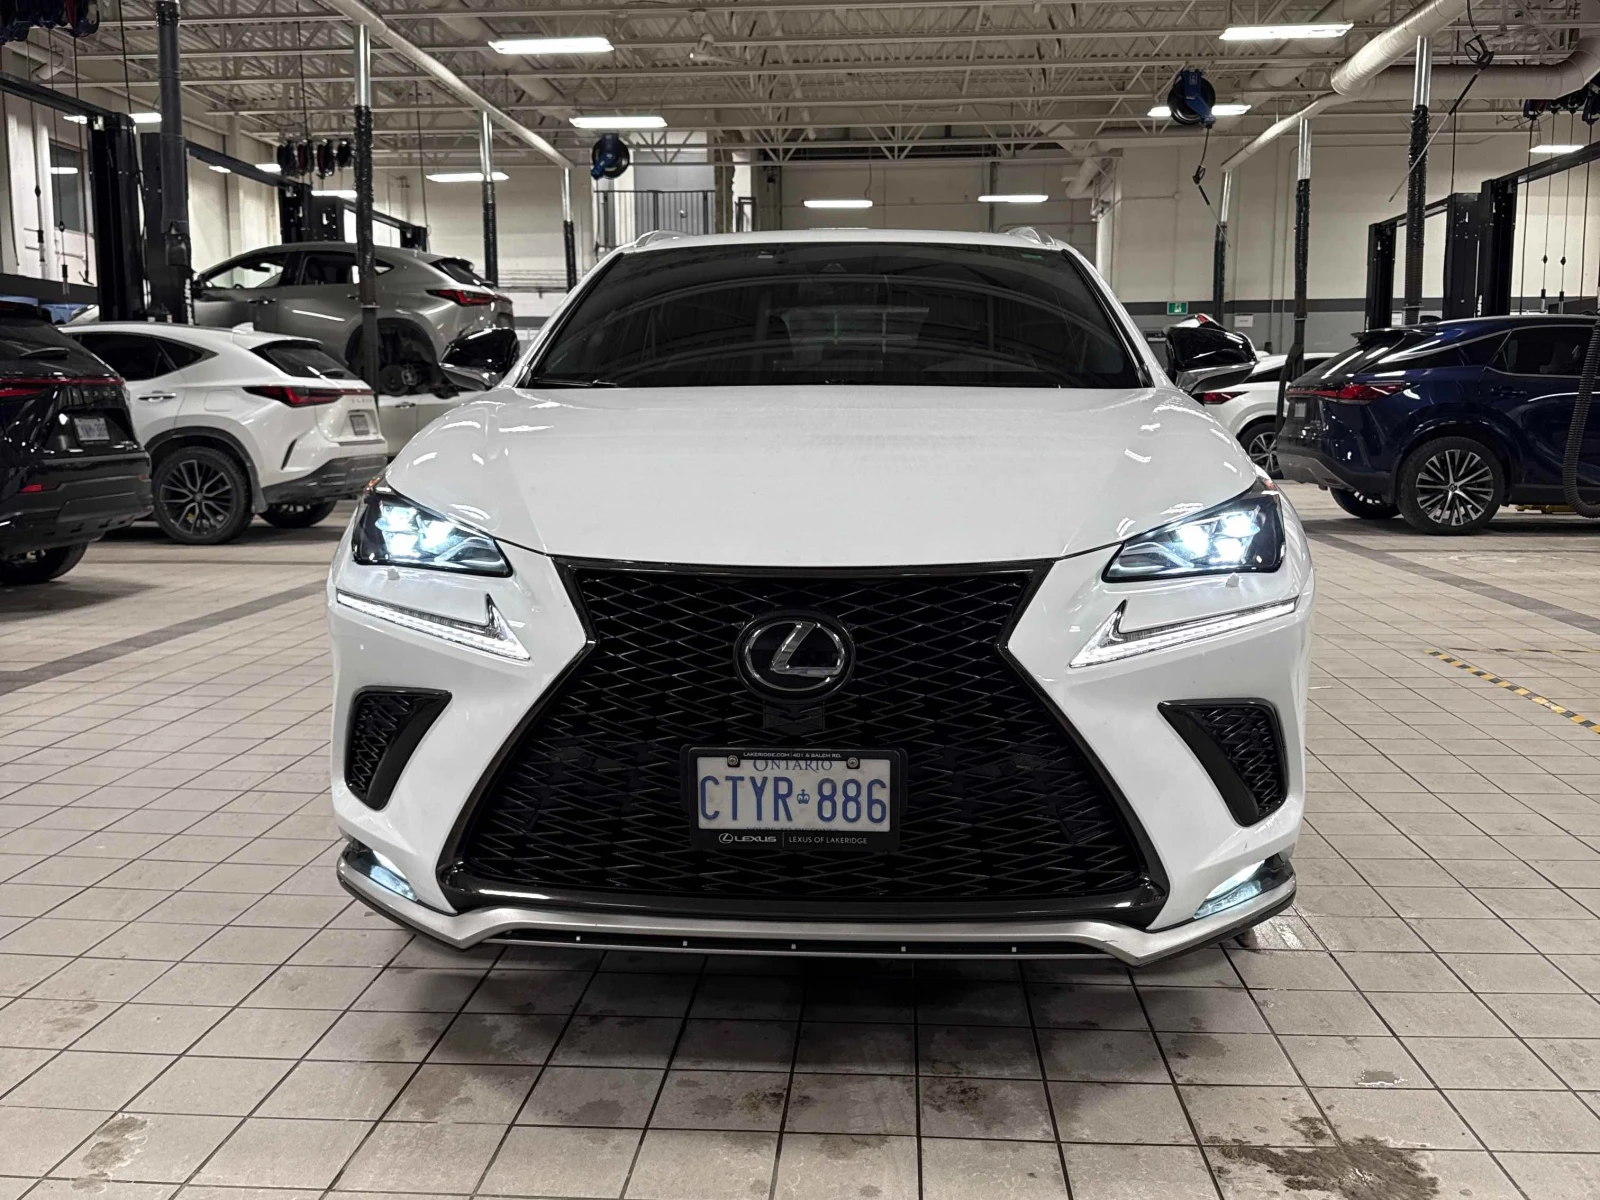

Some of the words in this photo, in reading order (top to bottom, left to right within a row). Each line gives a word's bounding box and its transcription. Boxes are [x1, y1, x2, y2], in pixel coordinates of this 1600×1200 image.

[753, 759, 833, 773] ONTARIO
[700, 775, 793, 822] CTYR
[817, 777, 887, 824] 886
[734, 835, 777, 843] LEXUS
[814, 836, 824, 844] OF
[826, 836, 868, 845] LAKERIDGE
